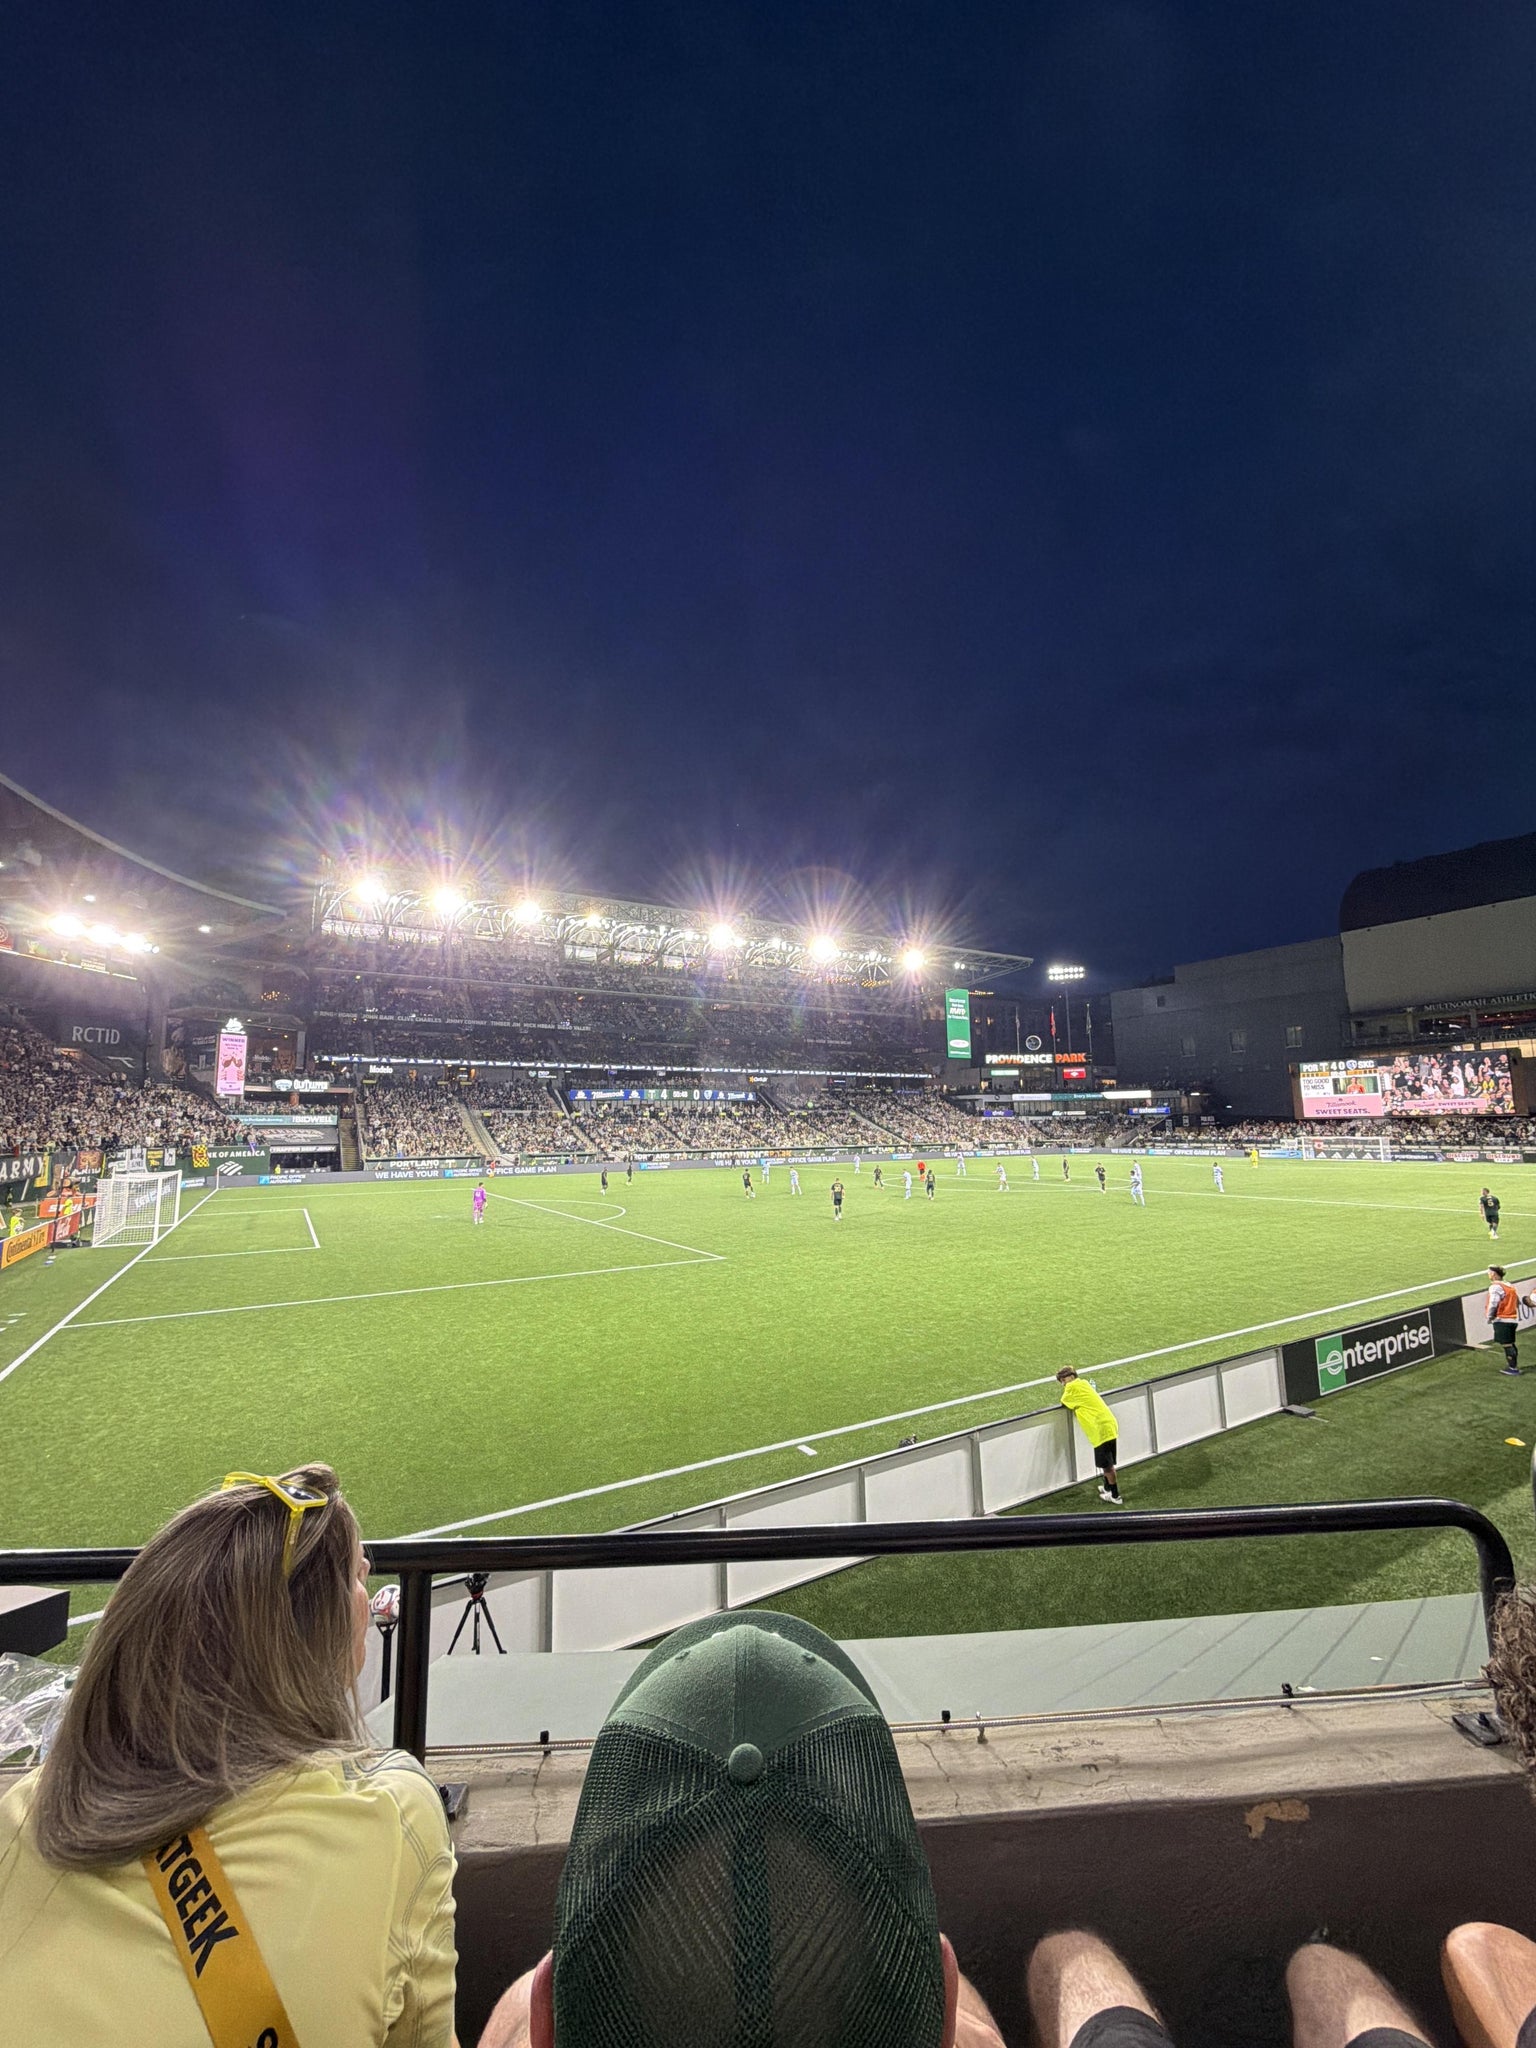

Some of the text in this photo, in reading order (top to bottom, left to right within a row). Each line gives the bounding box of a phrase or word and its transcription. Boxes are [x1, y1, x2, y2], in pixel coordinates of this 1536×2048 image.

[72, 1026, 120, 1044] RCTID
[985, 1052, 1087, 1064] PROVIDENCE PARK
[369, 1065, 393, 1074] Modelo
[1303, 1064, 1319, 1072] POR
[1330, 1061, 1337, 1070] 4
[1338, 1061, 1345, 1070] 0
[660, 1089, 668, 1099] 4
[693, 1089, 700, 1100] 0
[0, 1156, 44, 1180] ARMY
[390, 1171, 414, 1179] HAVE
[415, 1170, 439, 1178] YOUR
[7, 1236, 33, 1263] Continental
[1325, 1325, 1430, 1375] enterprise
